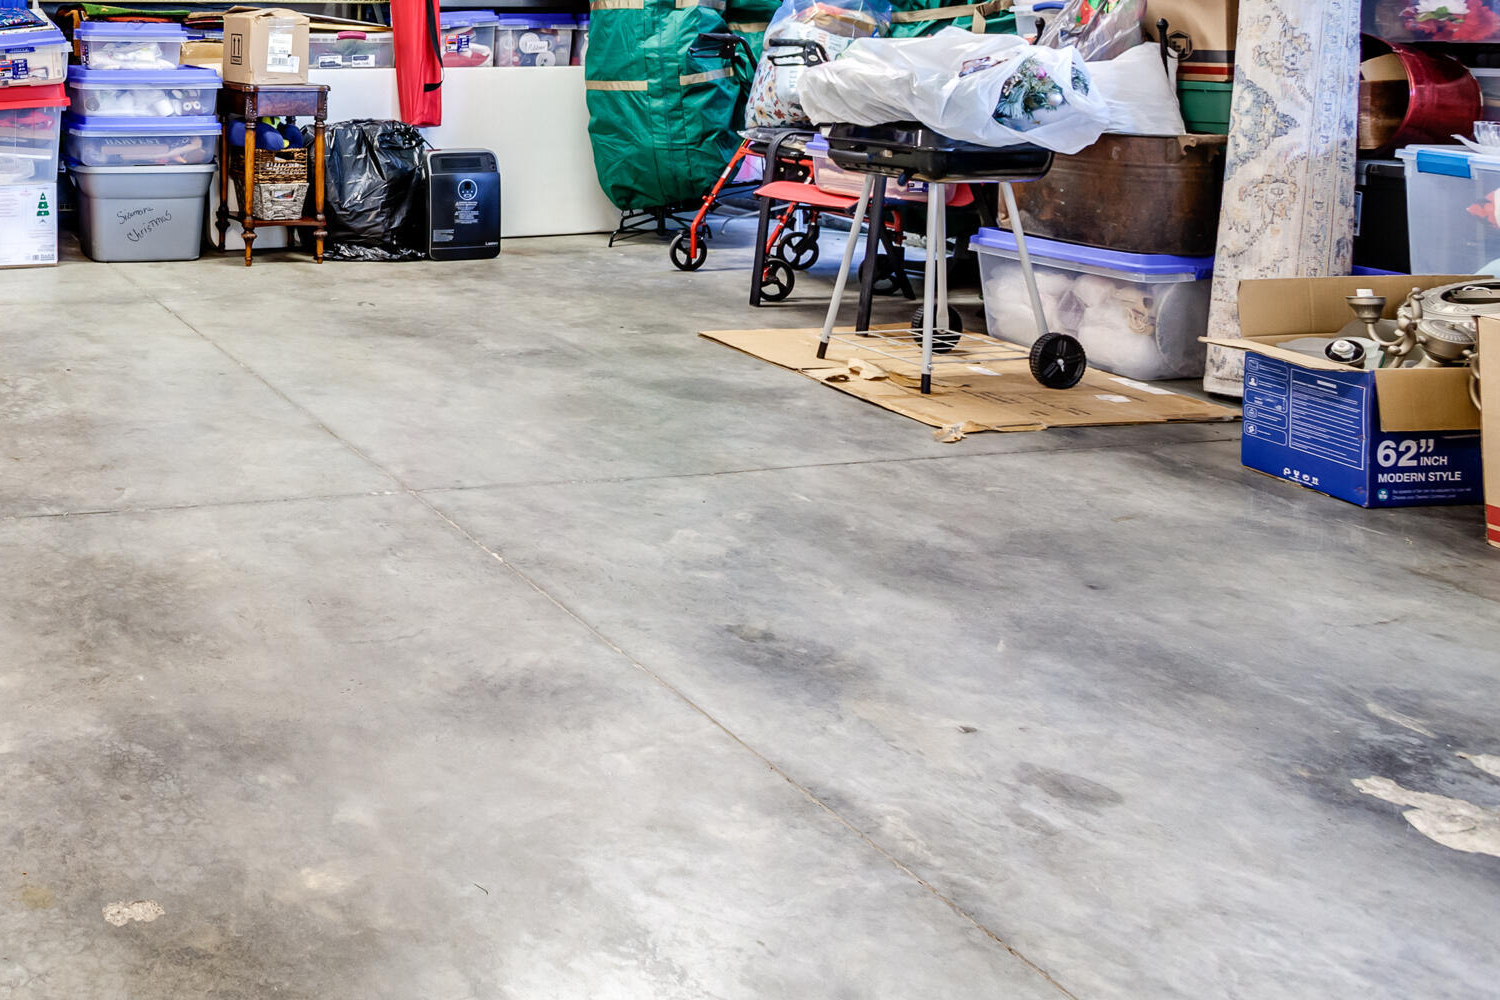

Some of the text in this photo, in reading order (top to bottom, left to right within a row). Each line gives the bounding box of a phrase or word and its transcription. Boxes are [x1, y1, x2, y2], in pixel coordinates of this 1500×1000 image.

[104, 137, 161, 146] HARVEST
[1419, 455, 1449, 467] INCH
[1377, 471, 1462, 484] MODERN STYLE
